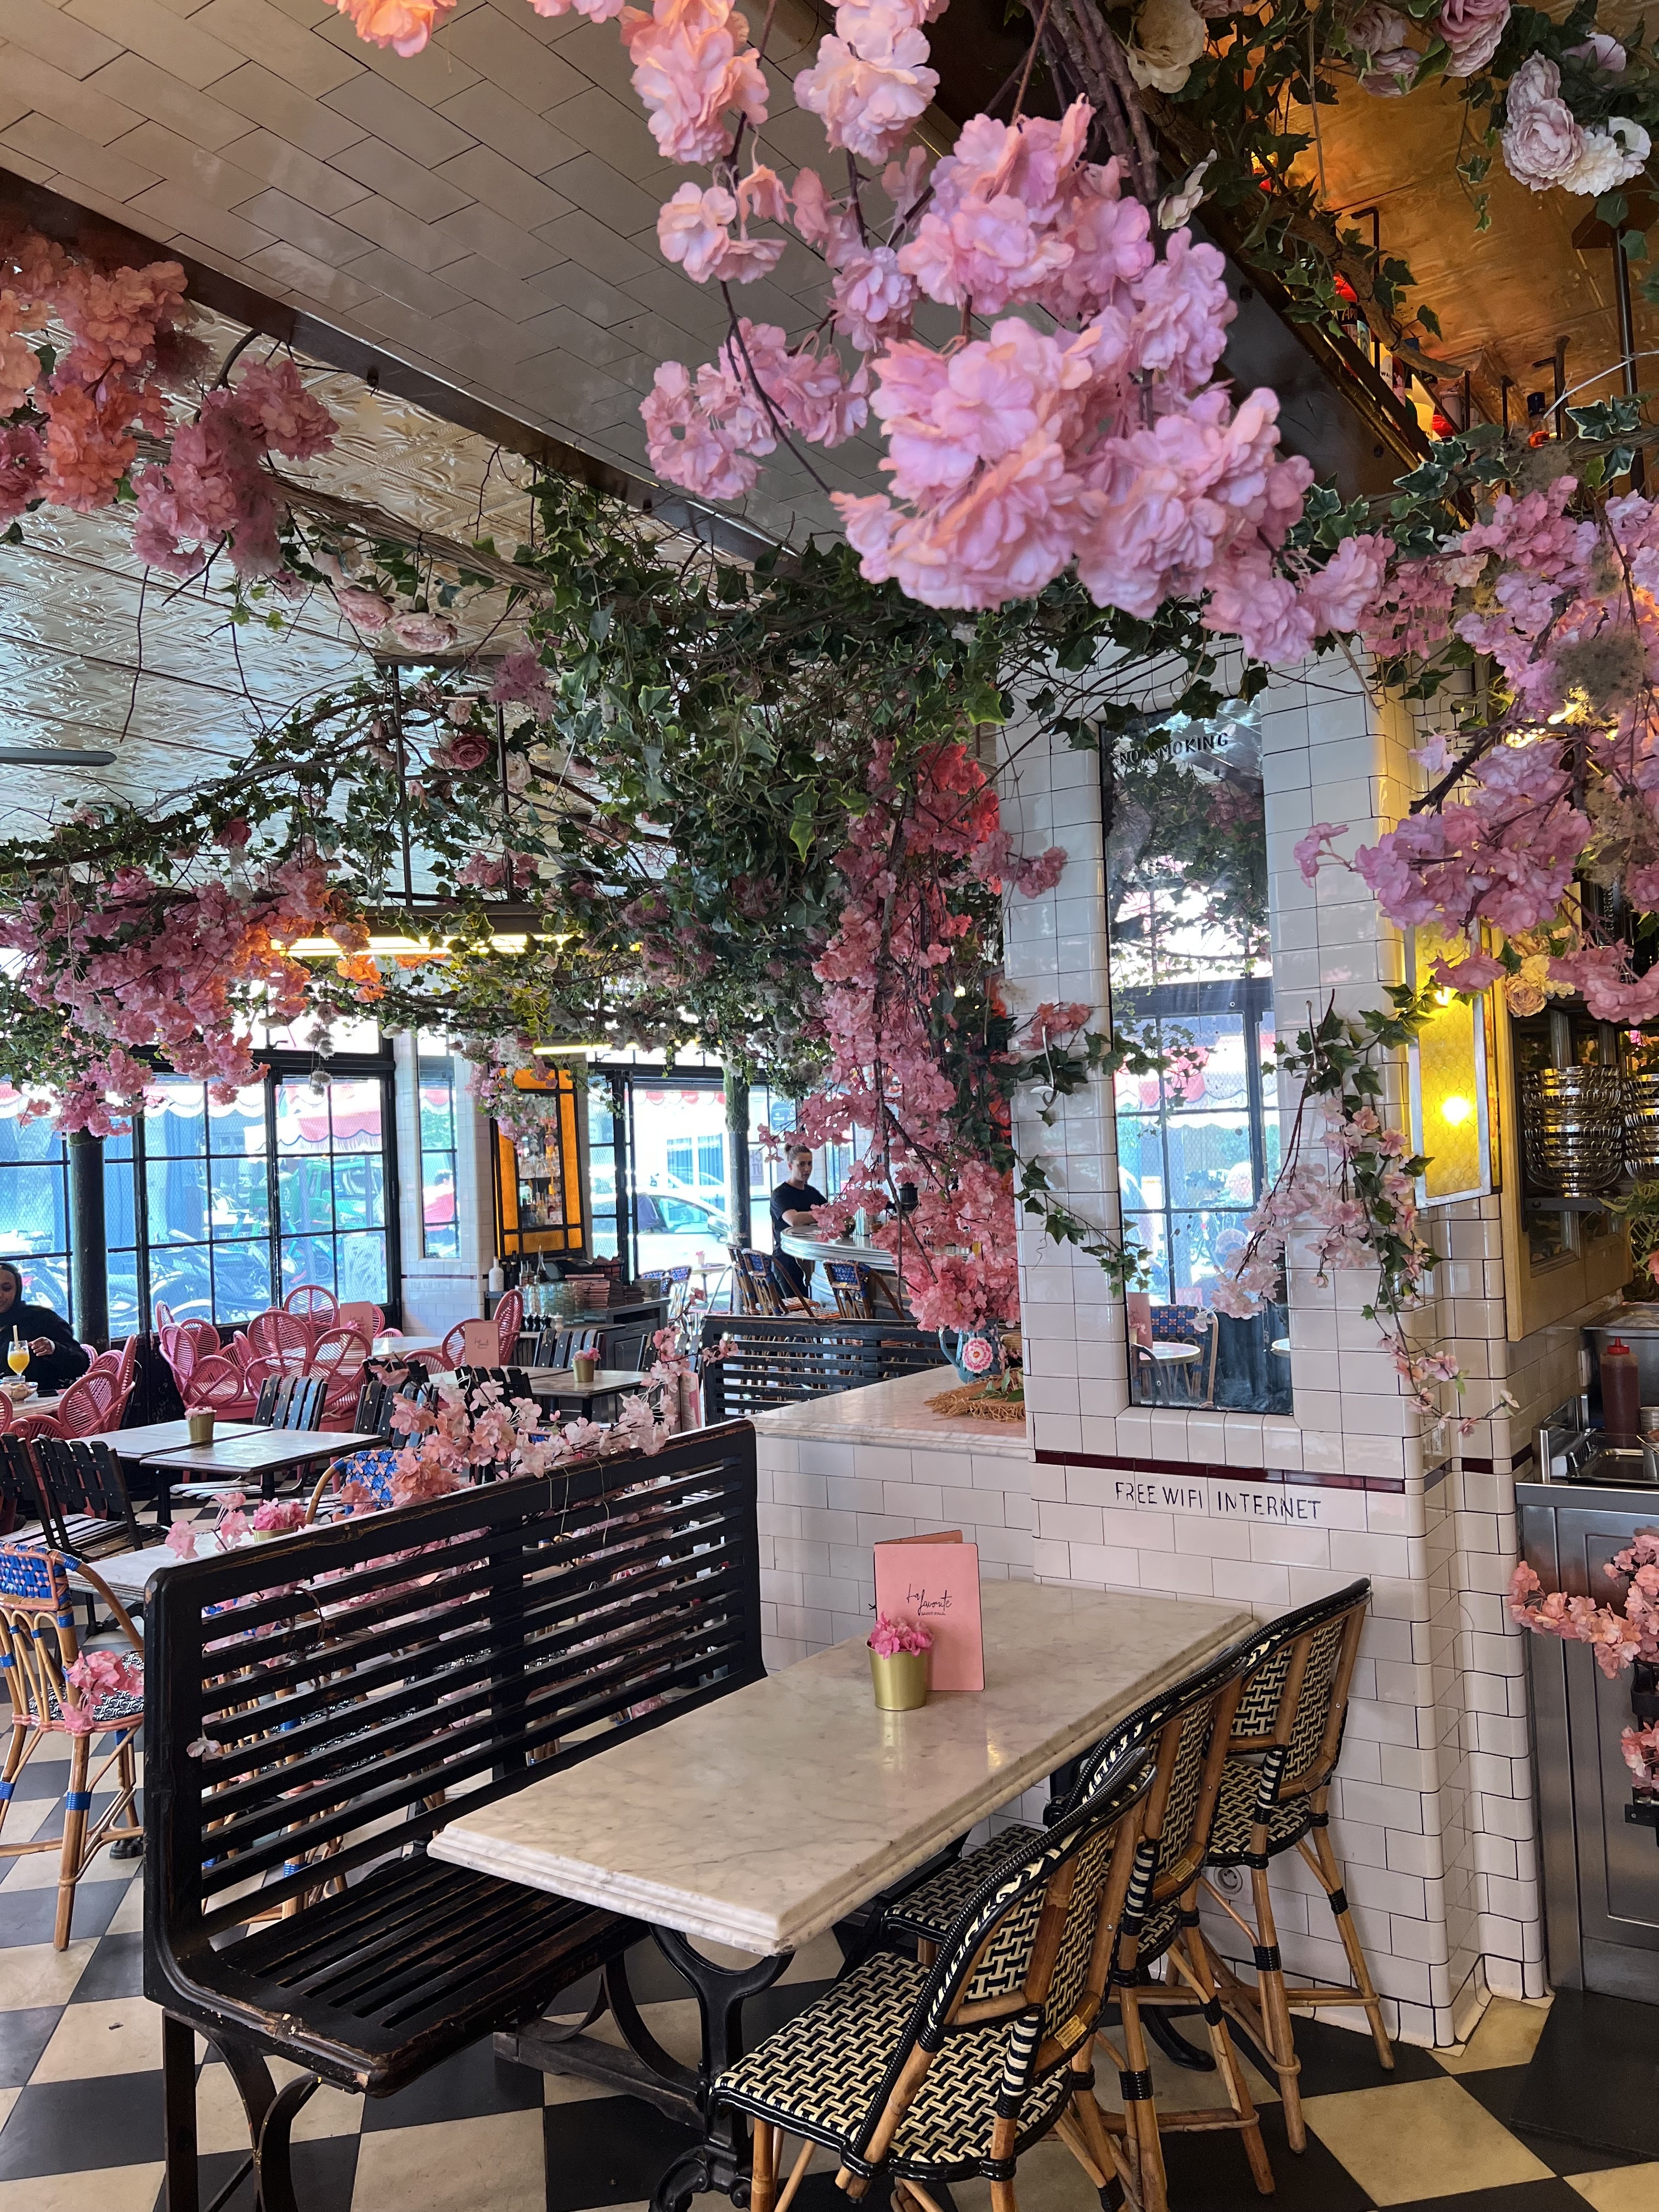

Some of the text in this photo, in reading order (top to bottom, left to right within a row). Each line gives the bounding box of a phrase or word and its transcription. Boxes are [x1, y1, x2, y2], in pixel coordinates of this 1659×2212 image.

[1119, 749, 1139, 765] NO
[1115, 1482, 1322, 1520] FREE WIFI INTERNET
